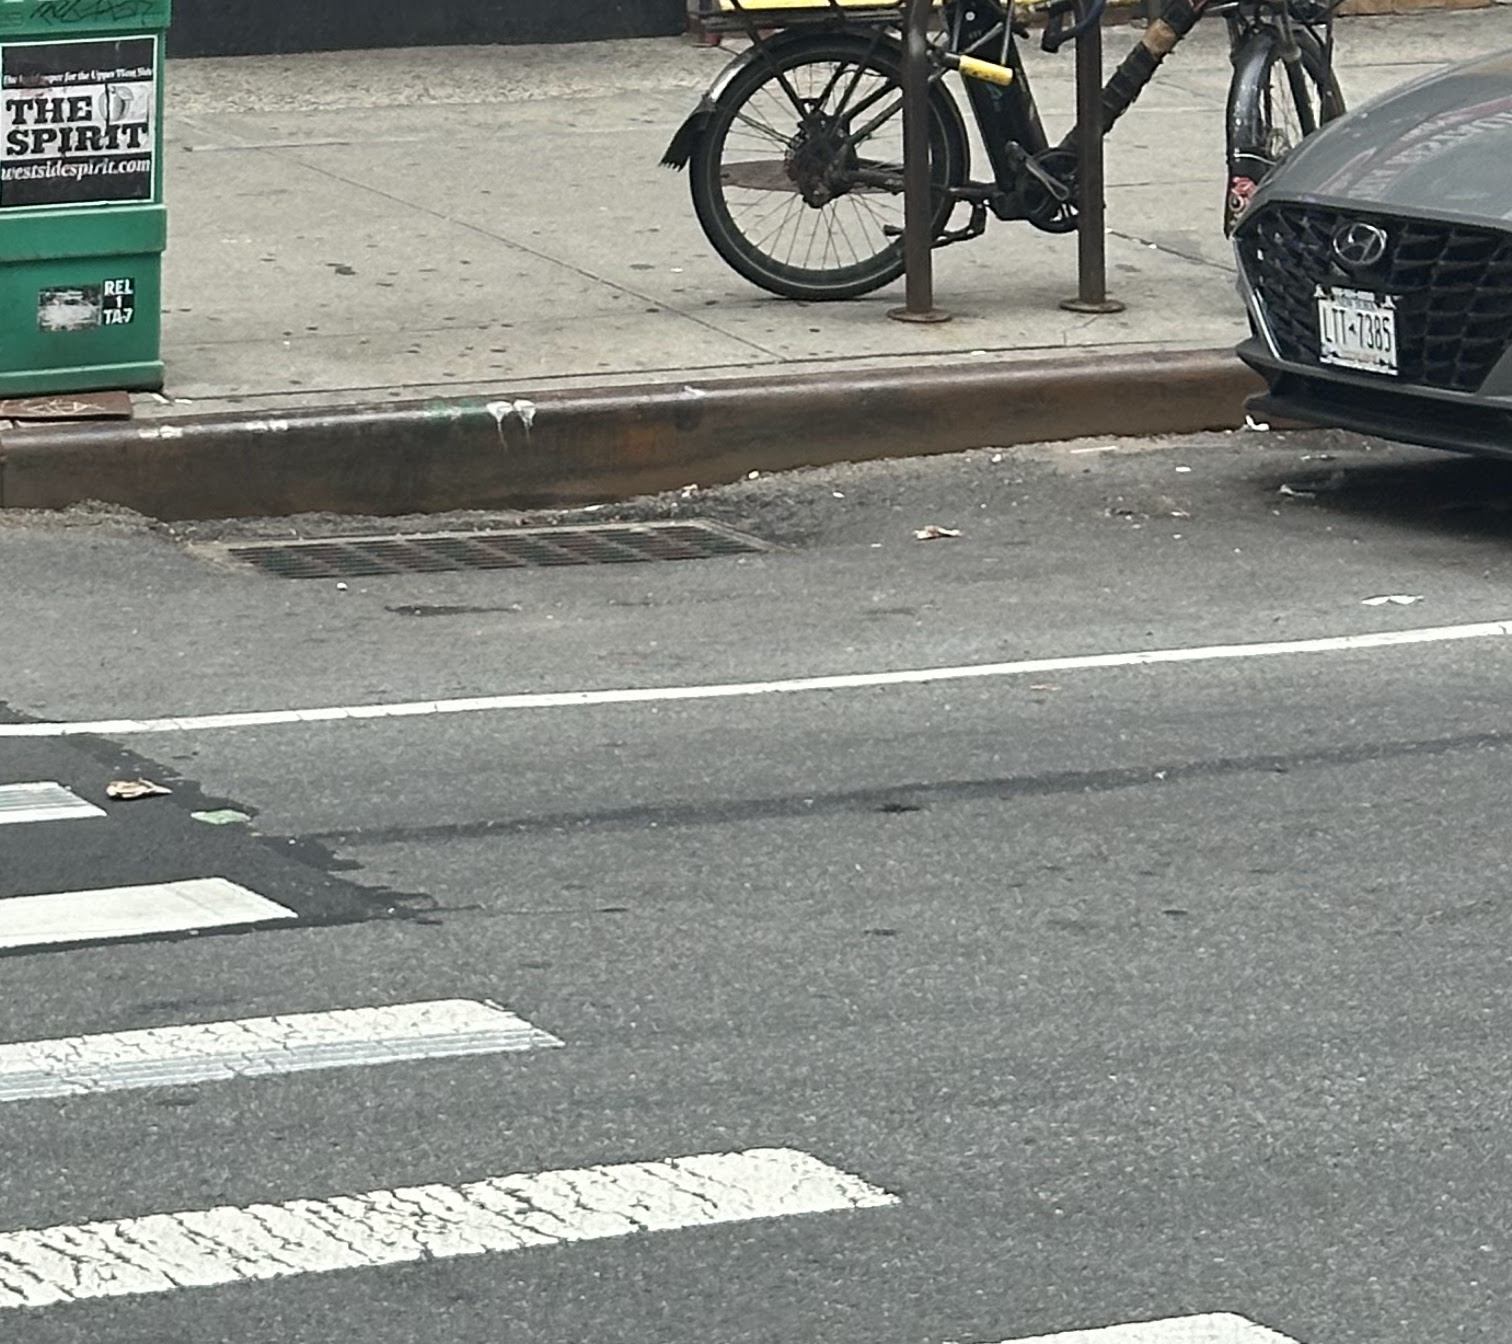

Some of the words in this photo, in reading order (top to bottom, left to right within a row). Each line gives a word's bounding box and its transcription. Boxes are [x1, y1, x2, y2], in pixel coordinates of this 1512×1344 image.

[6, 95, 93, 126] THE
[6, 122, 149, 157] SPIRIT
[0, 157, 151, 182] westsidespirit.com
[104, 278, 134, 296] REL
